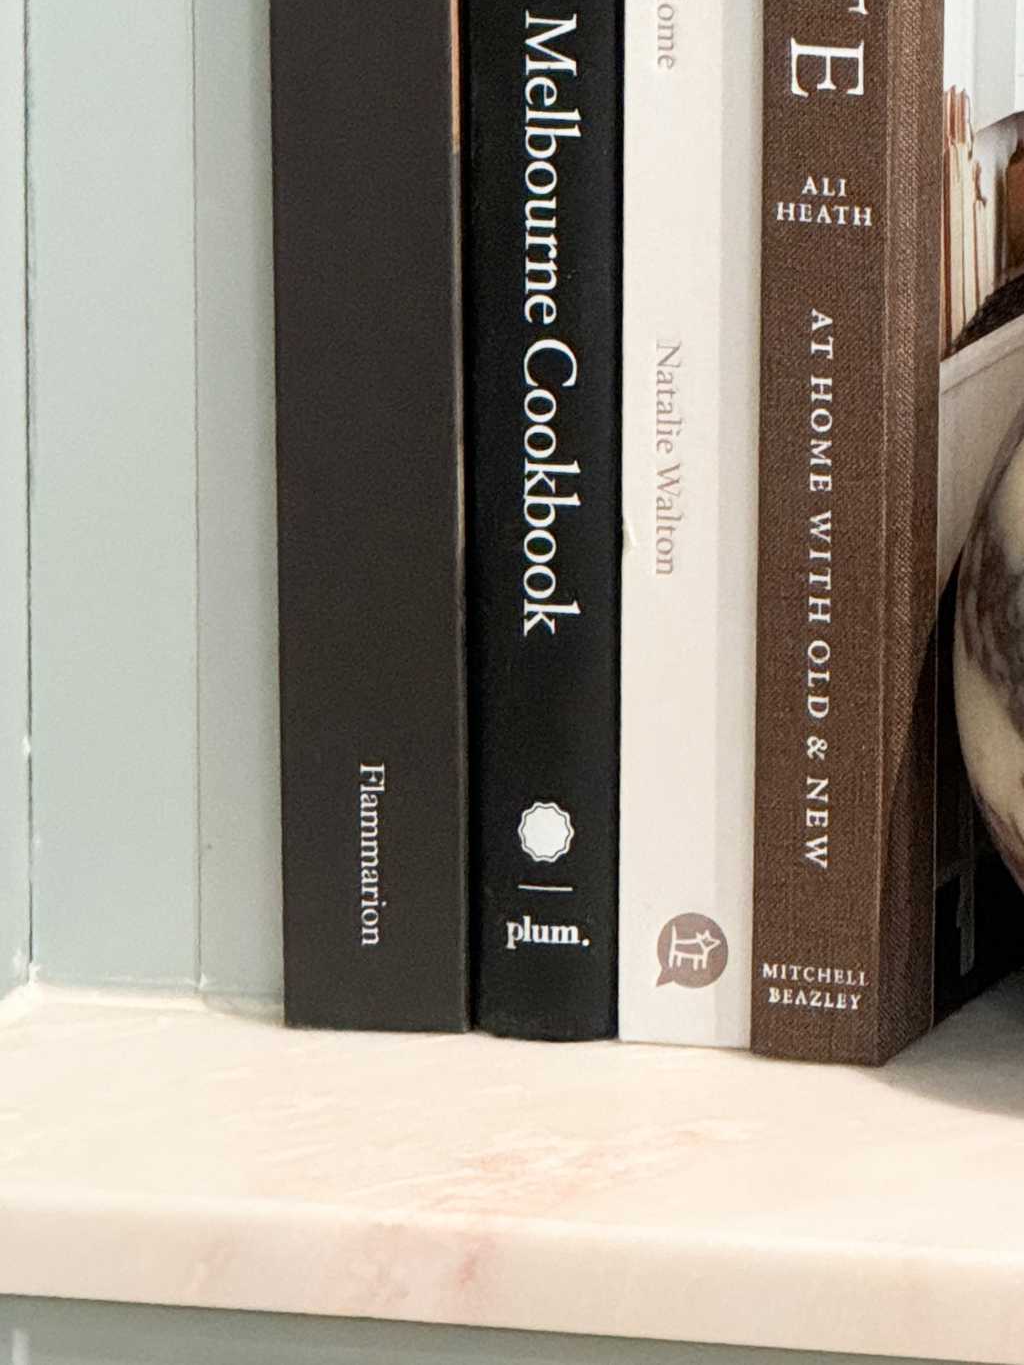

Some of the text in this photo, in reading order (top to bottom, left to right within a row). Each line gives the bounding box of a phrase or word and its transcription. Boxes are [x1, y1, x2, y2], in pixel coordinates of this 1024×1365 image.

[524, 10, 582, 325] Melbourne
[776, 176, 873, 227] ALI HEATH
[522, 338, 581, 637] Cookbook
[655, 344, 683, 575] Natalie Walton
[359, 339, 387, 945] Flammarion
[805, 308, 834, 869] AT HOME WITH OLD & NEW
[506, 915, 590, 950] plum.
[762, 962, 869, 988] MITCHELL
[768, 986, 863, 1011] BEAZLEY
